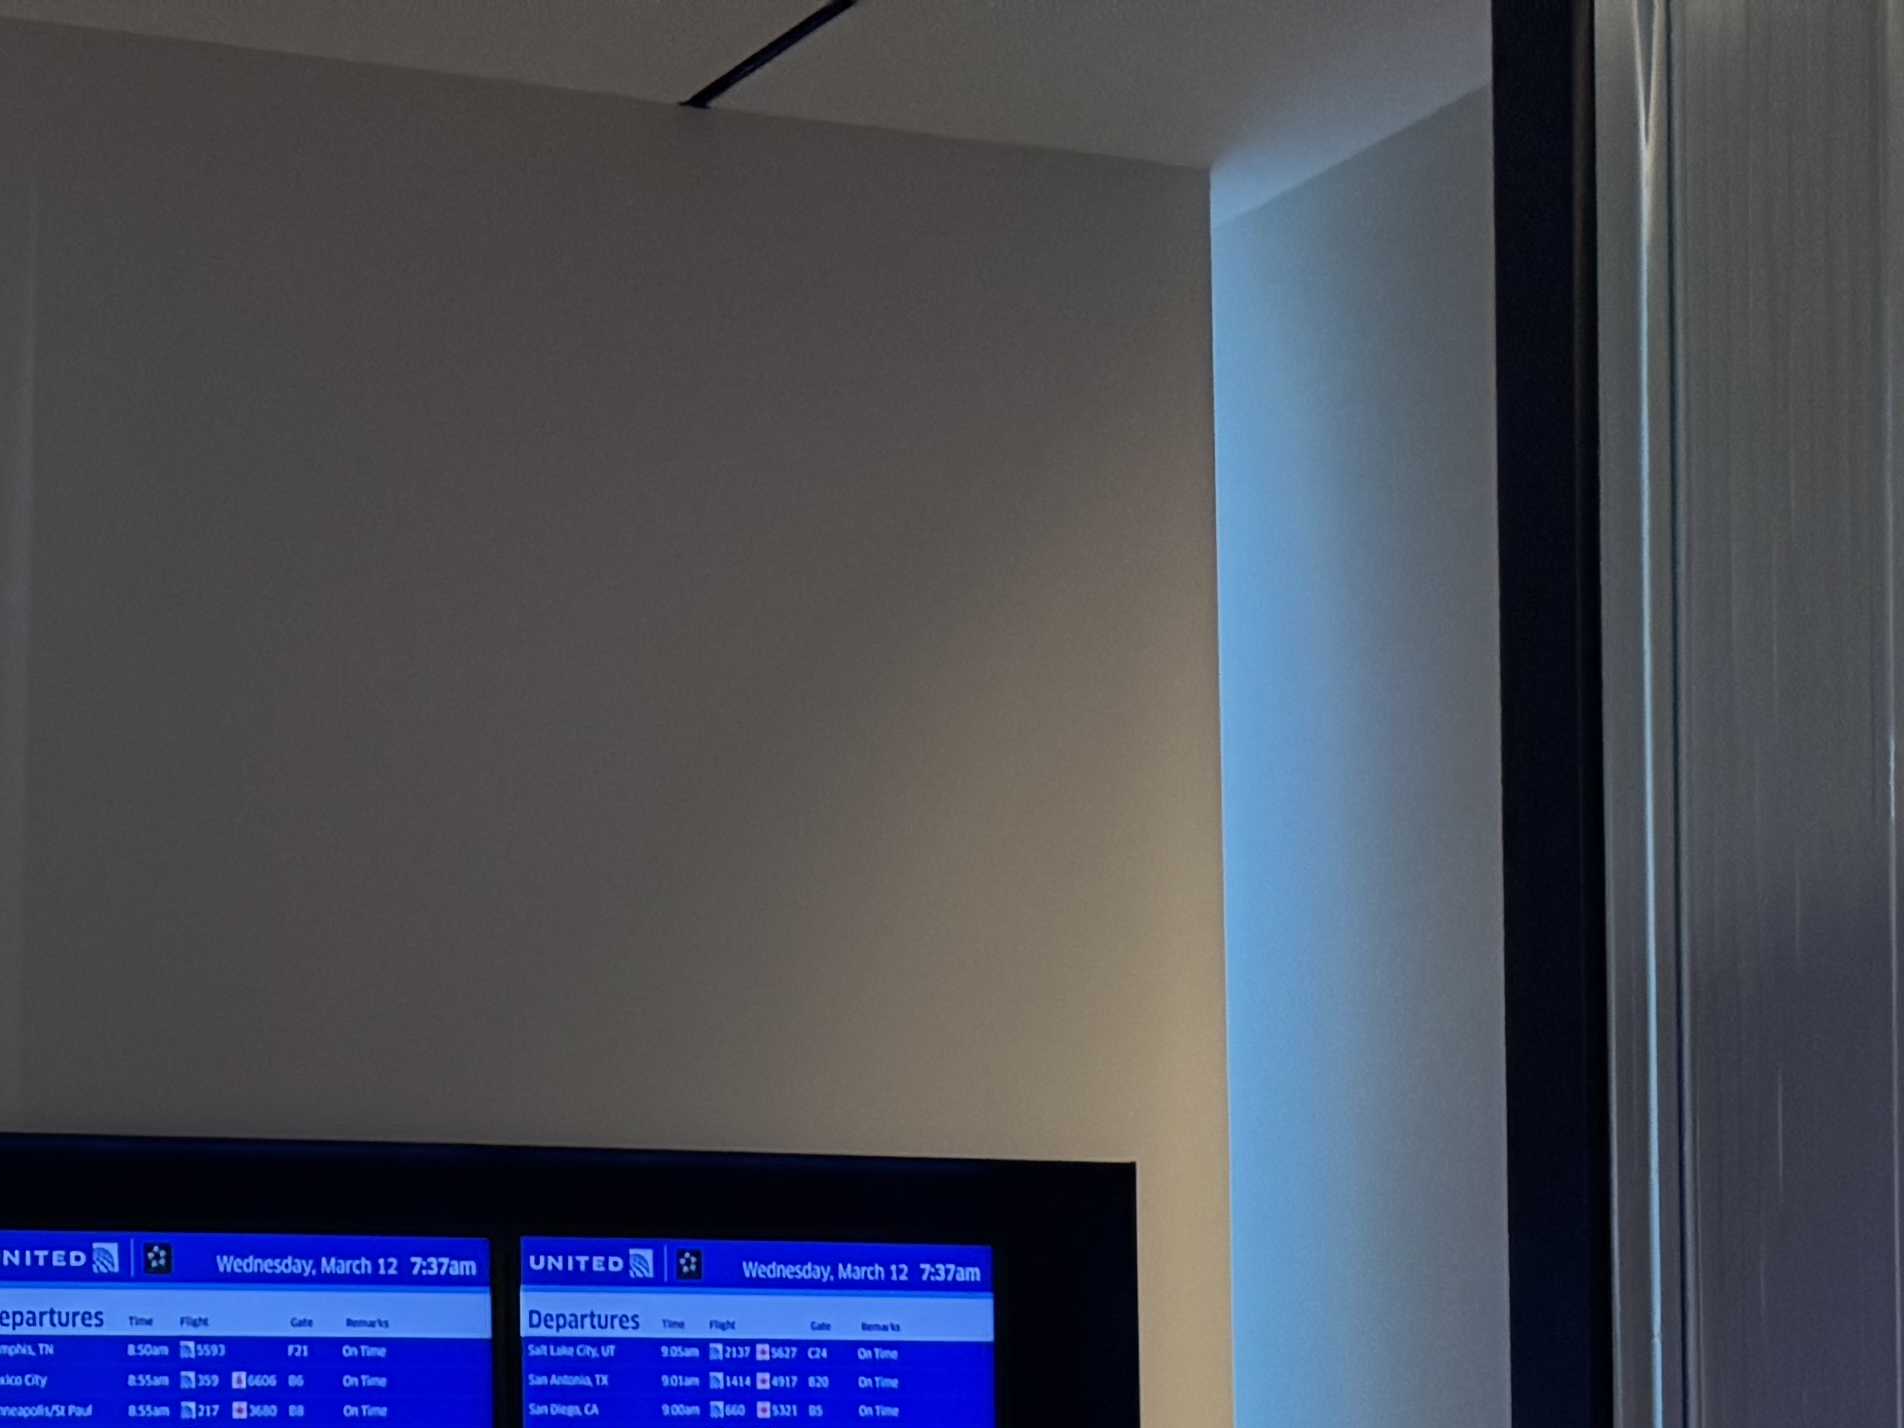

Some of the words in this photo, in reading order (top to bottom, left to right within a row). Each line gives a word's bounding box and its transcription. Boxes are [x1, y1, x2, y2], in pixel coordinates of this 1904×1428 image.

[215, 1254, 316, 1277] Wednesday,
[320, 1256, 372, 1275] March
[377, 1256, 398, 1275] 12
[409, 1256, 477, 1276] 7:37am
[529, 1254, 624, 1272] UNITED
[741, 1260, 834, 1283] Wednesday,
[837, 1262, 885, 1281] March
[889, 1263, 909, 1281] 12
[918, 1262, 981, 1282] 7:37am
[528, 1308, 640, 1333] Departures
